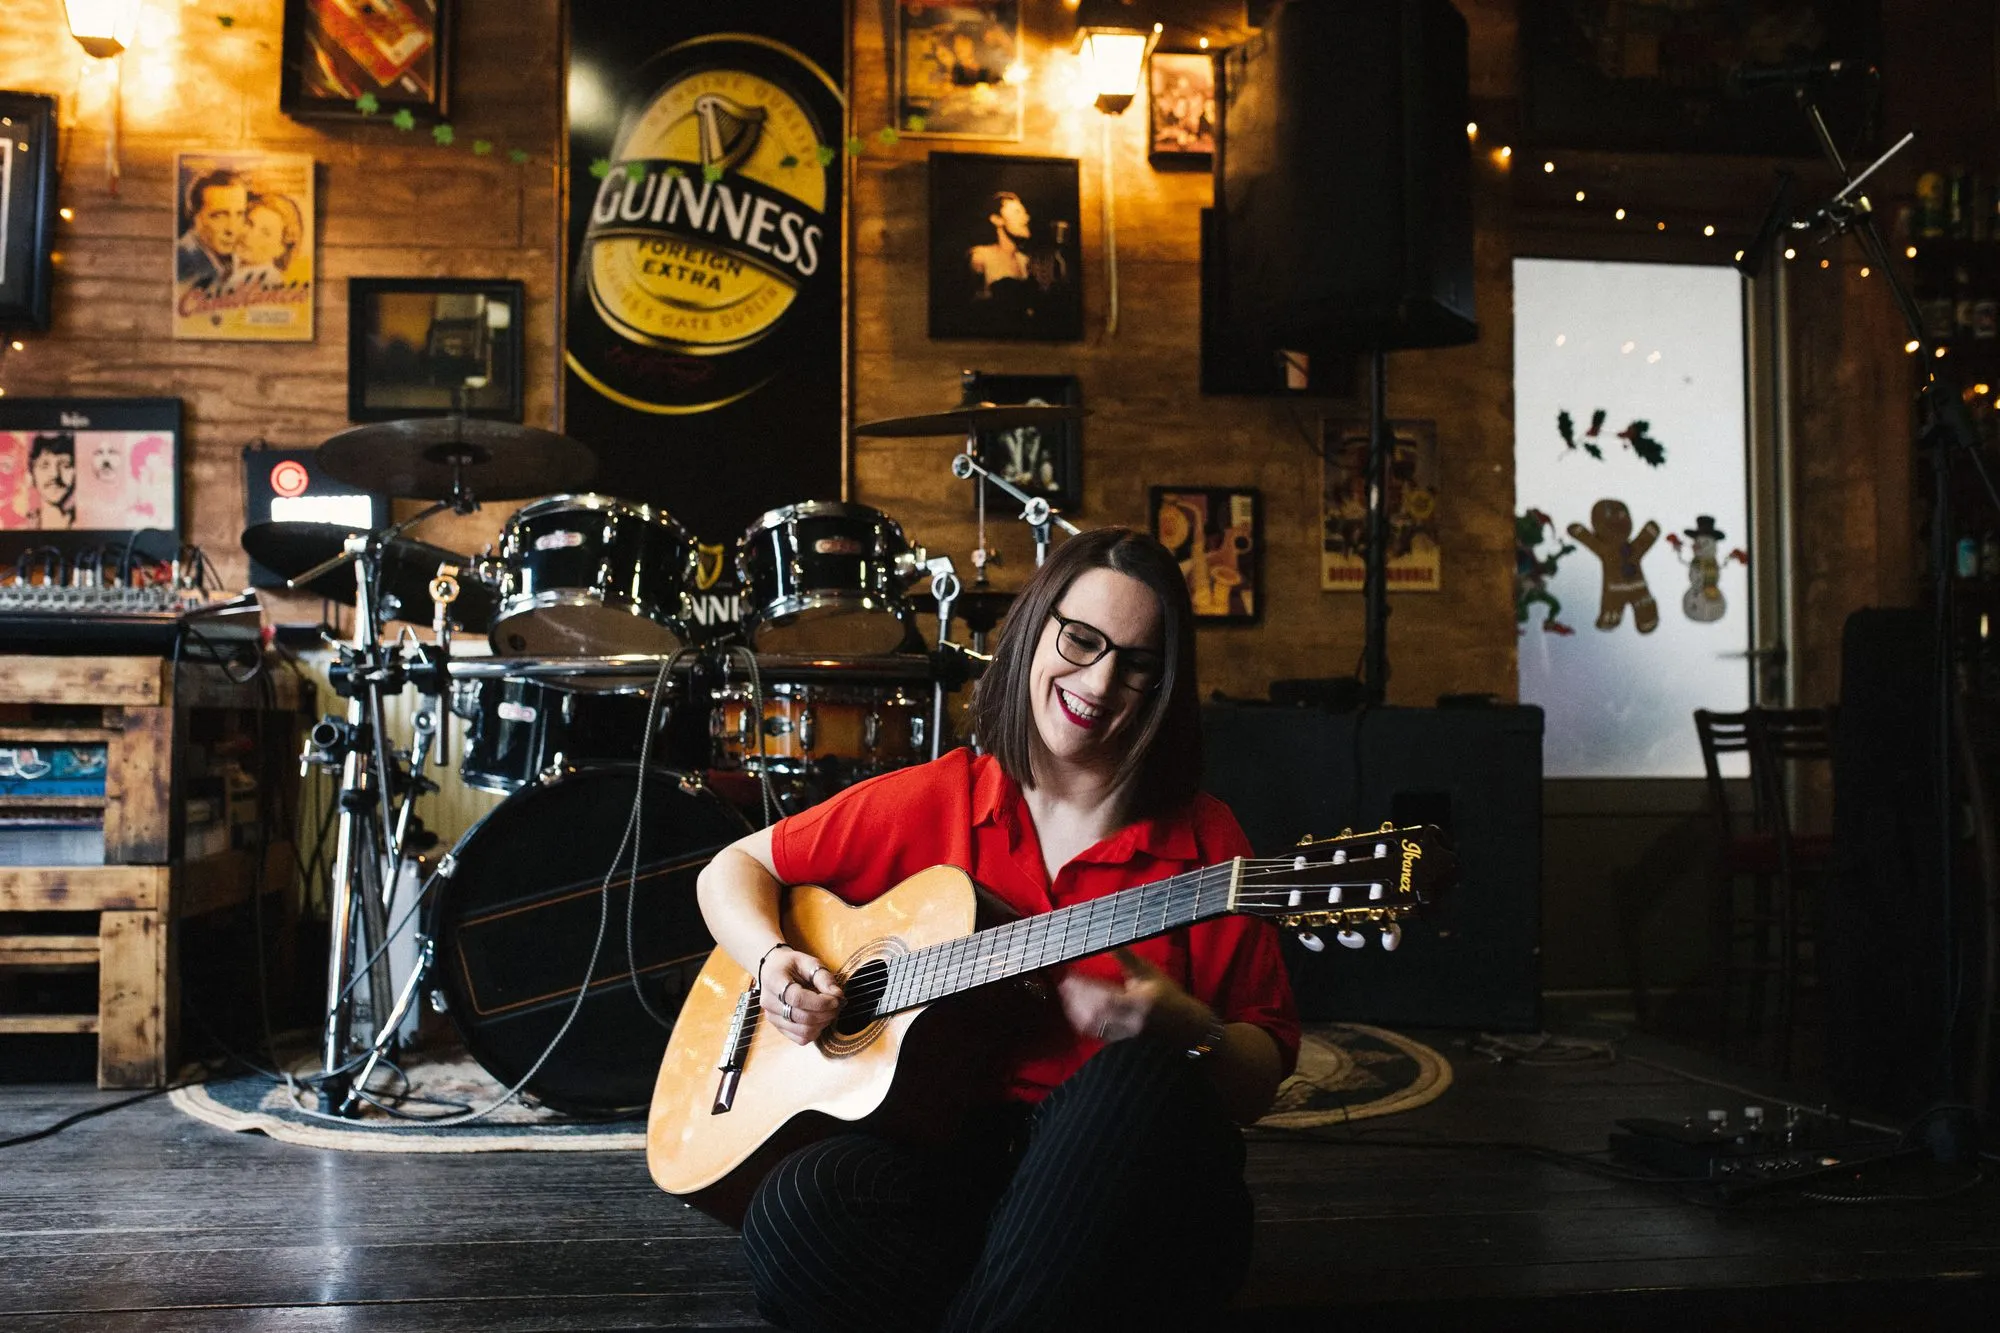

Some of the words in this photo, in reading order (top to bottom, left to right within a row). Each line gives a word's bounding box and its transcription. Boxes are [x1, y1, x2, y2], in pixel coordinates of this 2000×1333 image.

[593, 166, 822, 276] GUINNESS
[637, 238, 744, 278] FOREIGN
[641, 258, 723, 293] EXTRA
[1399, 838, 1422, 894] Ibanez
